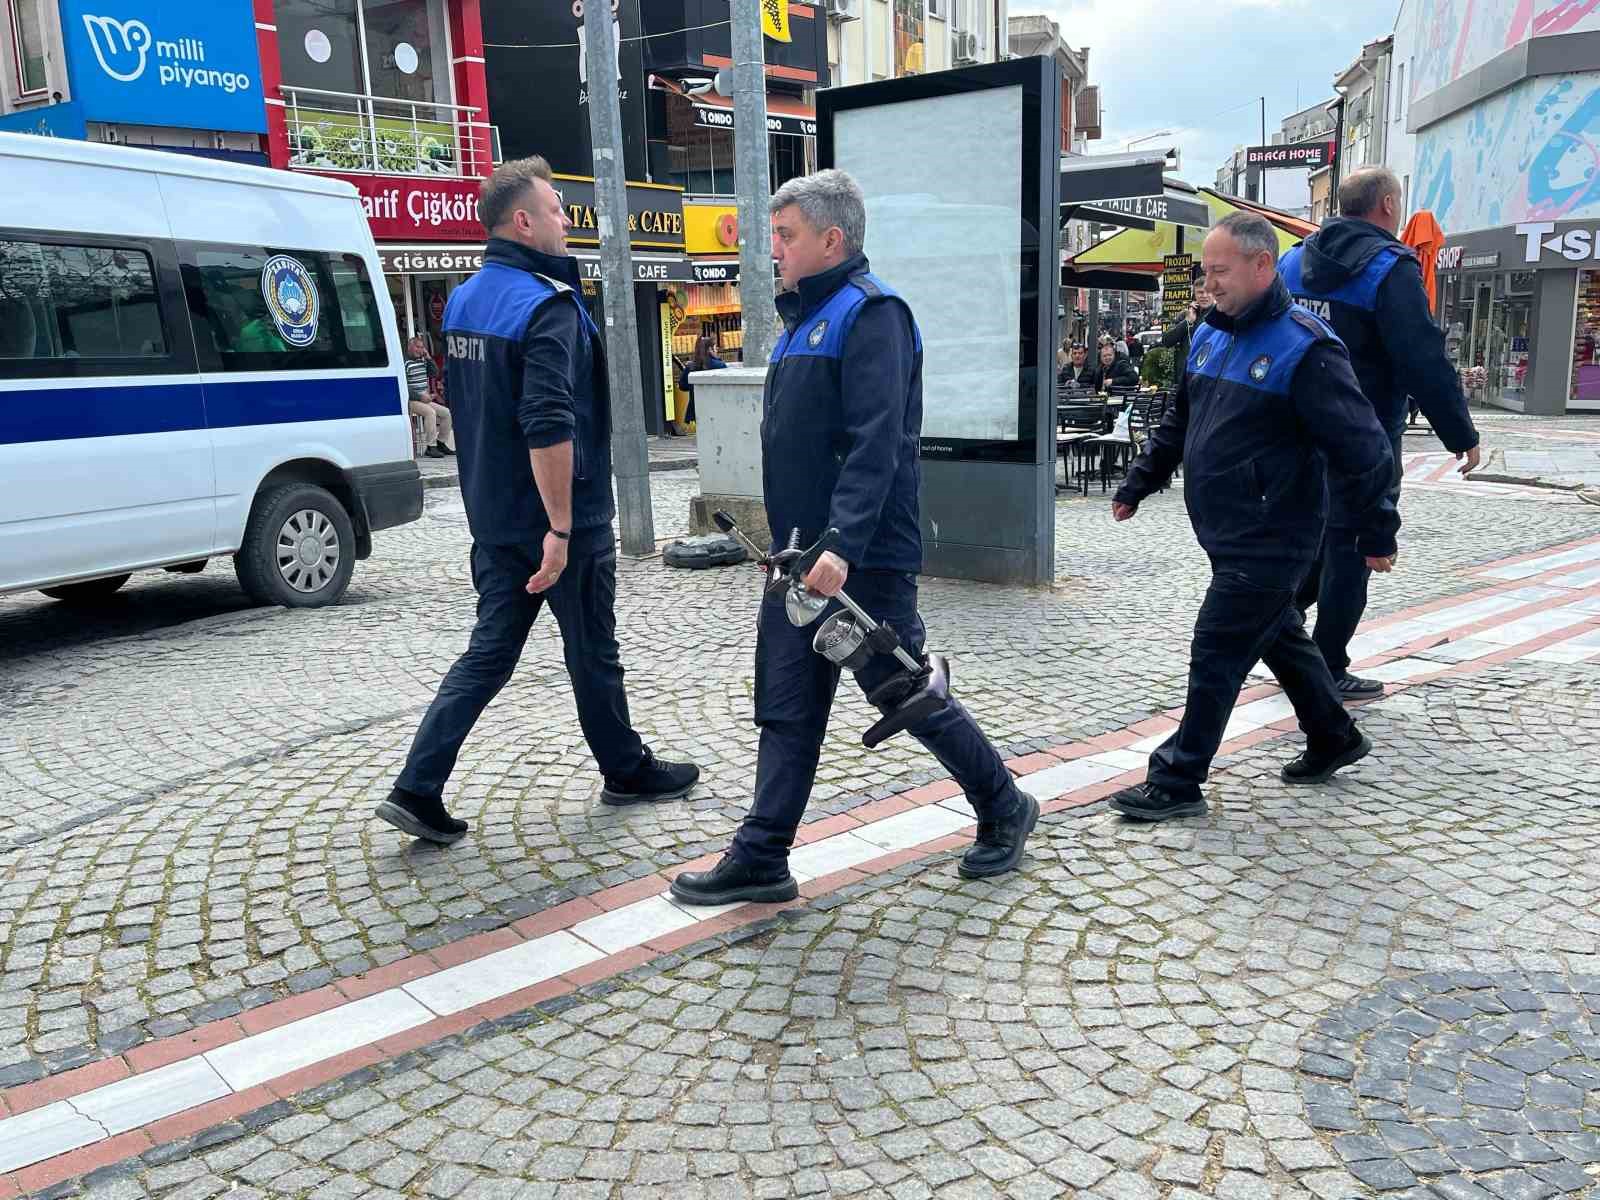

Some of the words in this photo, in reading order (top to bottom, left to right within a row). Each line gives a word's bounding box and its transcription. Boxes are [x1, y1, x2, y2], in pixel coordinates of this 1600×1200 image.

[156, 38, 204, 62] milli
[160, 61, 250, 93] piyango
[767, 119, 782, 130] NDO
[1289, 148, 1321, 160] HOME
[358, 188, 399, 218] arif
[406, 190, 480, 227] Çiğköft
[569, 204, 599, 229] TA
[628, 213, 637, 232] &
[640, 209, 682, 234] CAFE
[1146, 198, 1168, 219] CAFE
[1438, 246, 1462, 269] SHOP
[585, 263, 601, 277] TA
[638, 264, 668, 278] CAFE
[702, 267, 727, 279] ONDO
[446, 335, 485, 361] ABITA
